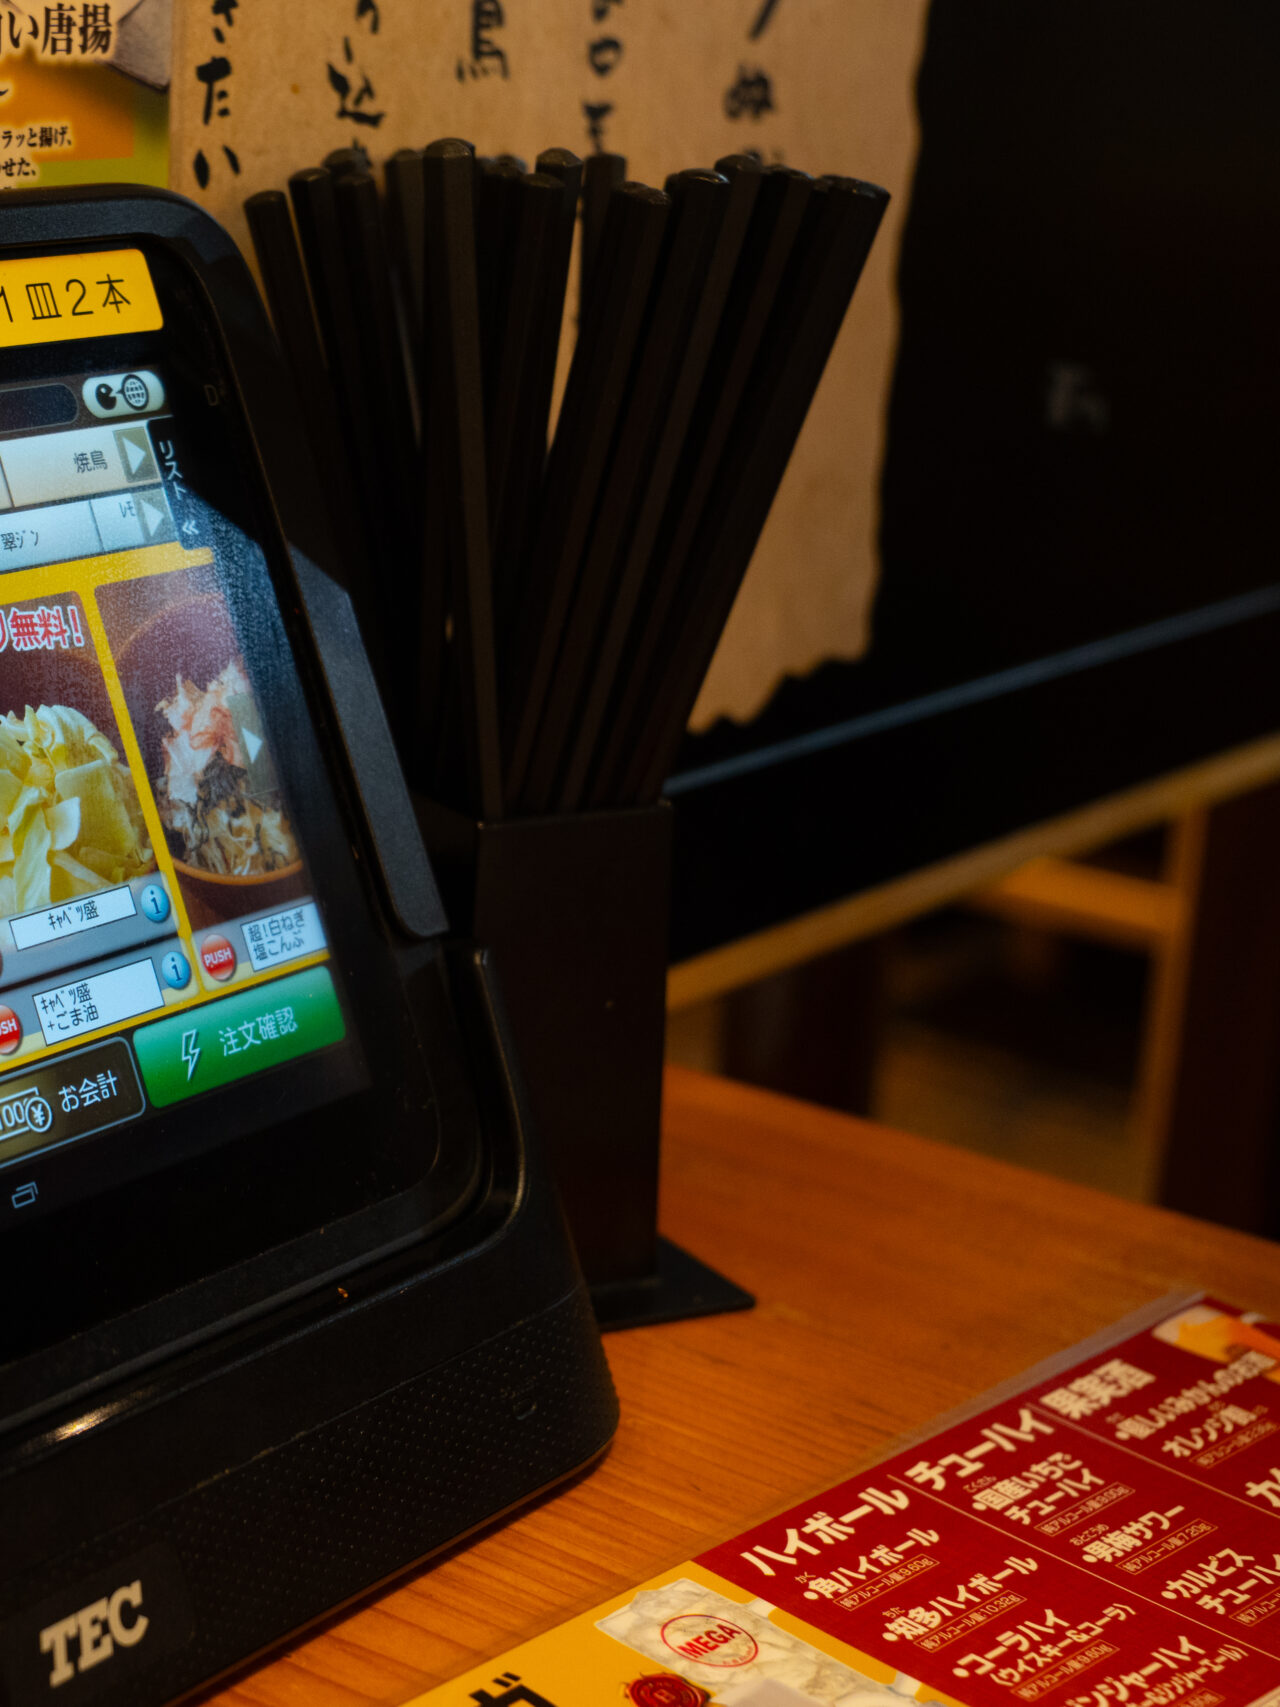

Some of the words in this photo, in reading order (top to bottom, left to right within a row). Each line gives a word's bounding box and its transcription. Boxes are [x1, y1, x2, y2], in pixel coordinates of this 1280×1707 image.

[72, 449, 109, 475] 焼鳥
[159, 439, 187, 500] リスト
[0, 528, 40, 553] 翠ジン
[203, 946, 232, 967] PUSH
[254, 931, 305, 962] 塩こんぶ
[219, 1006, 299, 1058] 注文確認
[58, 1069, 118, 1113] お会計
[903, 1408, 1055, 1491] チューハイ
[972, 1451, 1084, 1512] 国産いちご
[1003, 1467, 1106, 1526] チューハイ
[739, 1486, 910, 1577] ハイボール
[1082, 1504, 1185, 1563] 男梅サワー
[807, 1527, 940, 1600] 角ハイボール
[1165, 1547, 1256, 1599] カルピス
[1195, 1554, 1280, 1616] チューハ
[884, 1556, 1039, 1641] 知多ハイボール
[39, 1580, 150, 1688] TEC
[677, 1623, 742, 1660] MEGA
[956, 1608, 1070, 1676] コーラハイ
[1065, 1635, 1207, 1707] ンジャーハイ
